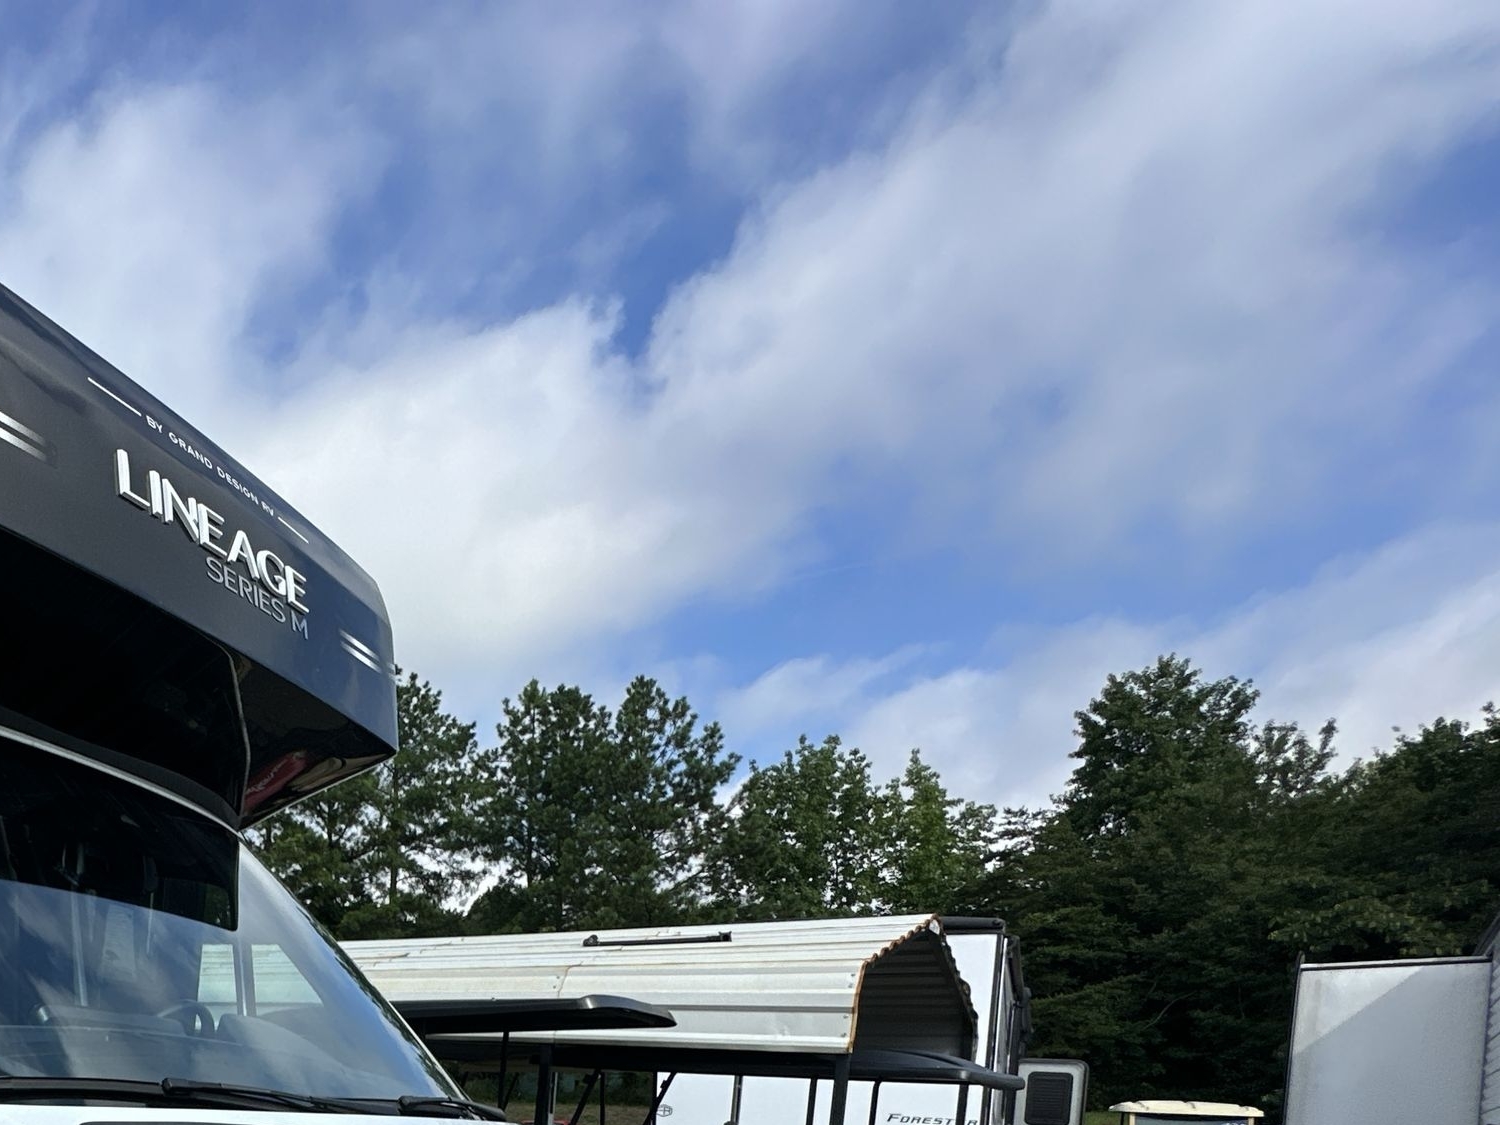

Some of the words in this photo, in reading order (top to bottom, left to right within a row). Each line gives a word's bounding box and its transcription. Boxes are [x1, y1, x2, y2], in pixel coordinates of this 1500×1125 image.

[146, 414, 163, 433] BY
[168, 432, 213, 469] GRAND
[216, 466, 259, 505] DESIGN
[261, 501, 274, 517] RV
[115, 448, 310, 614] LINEAGE
[205, 556, 286, 623] SERIES
[291, 609, 309, 641] M
